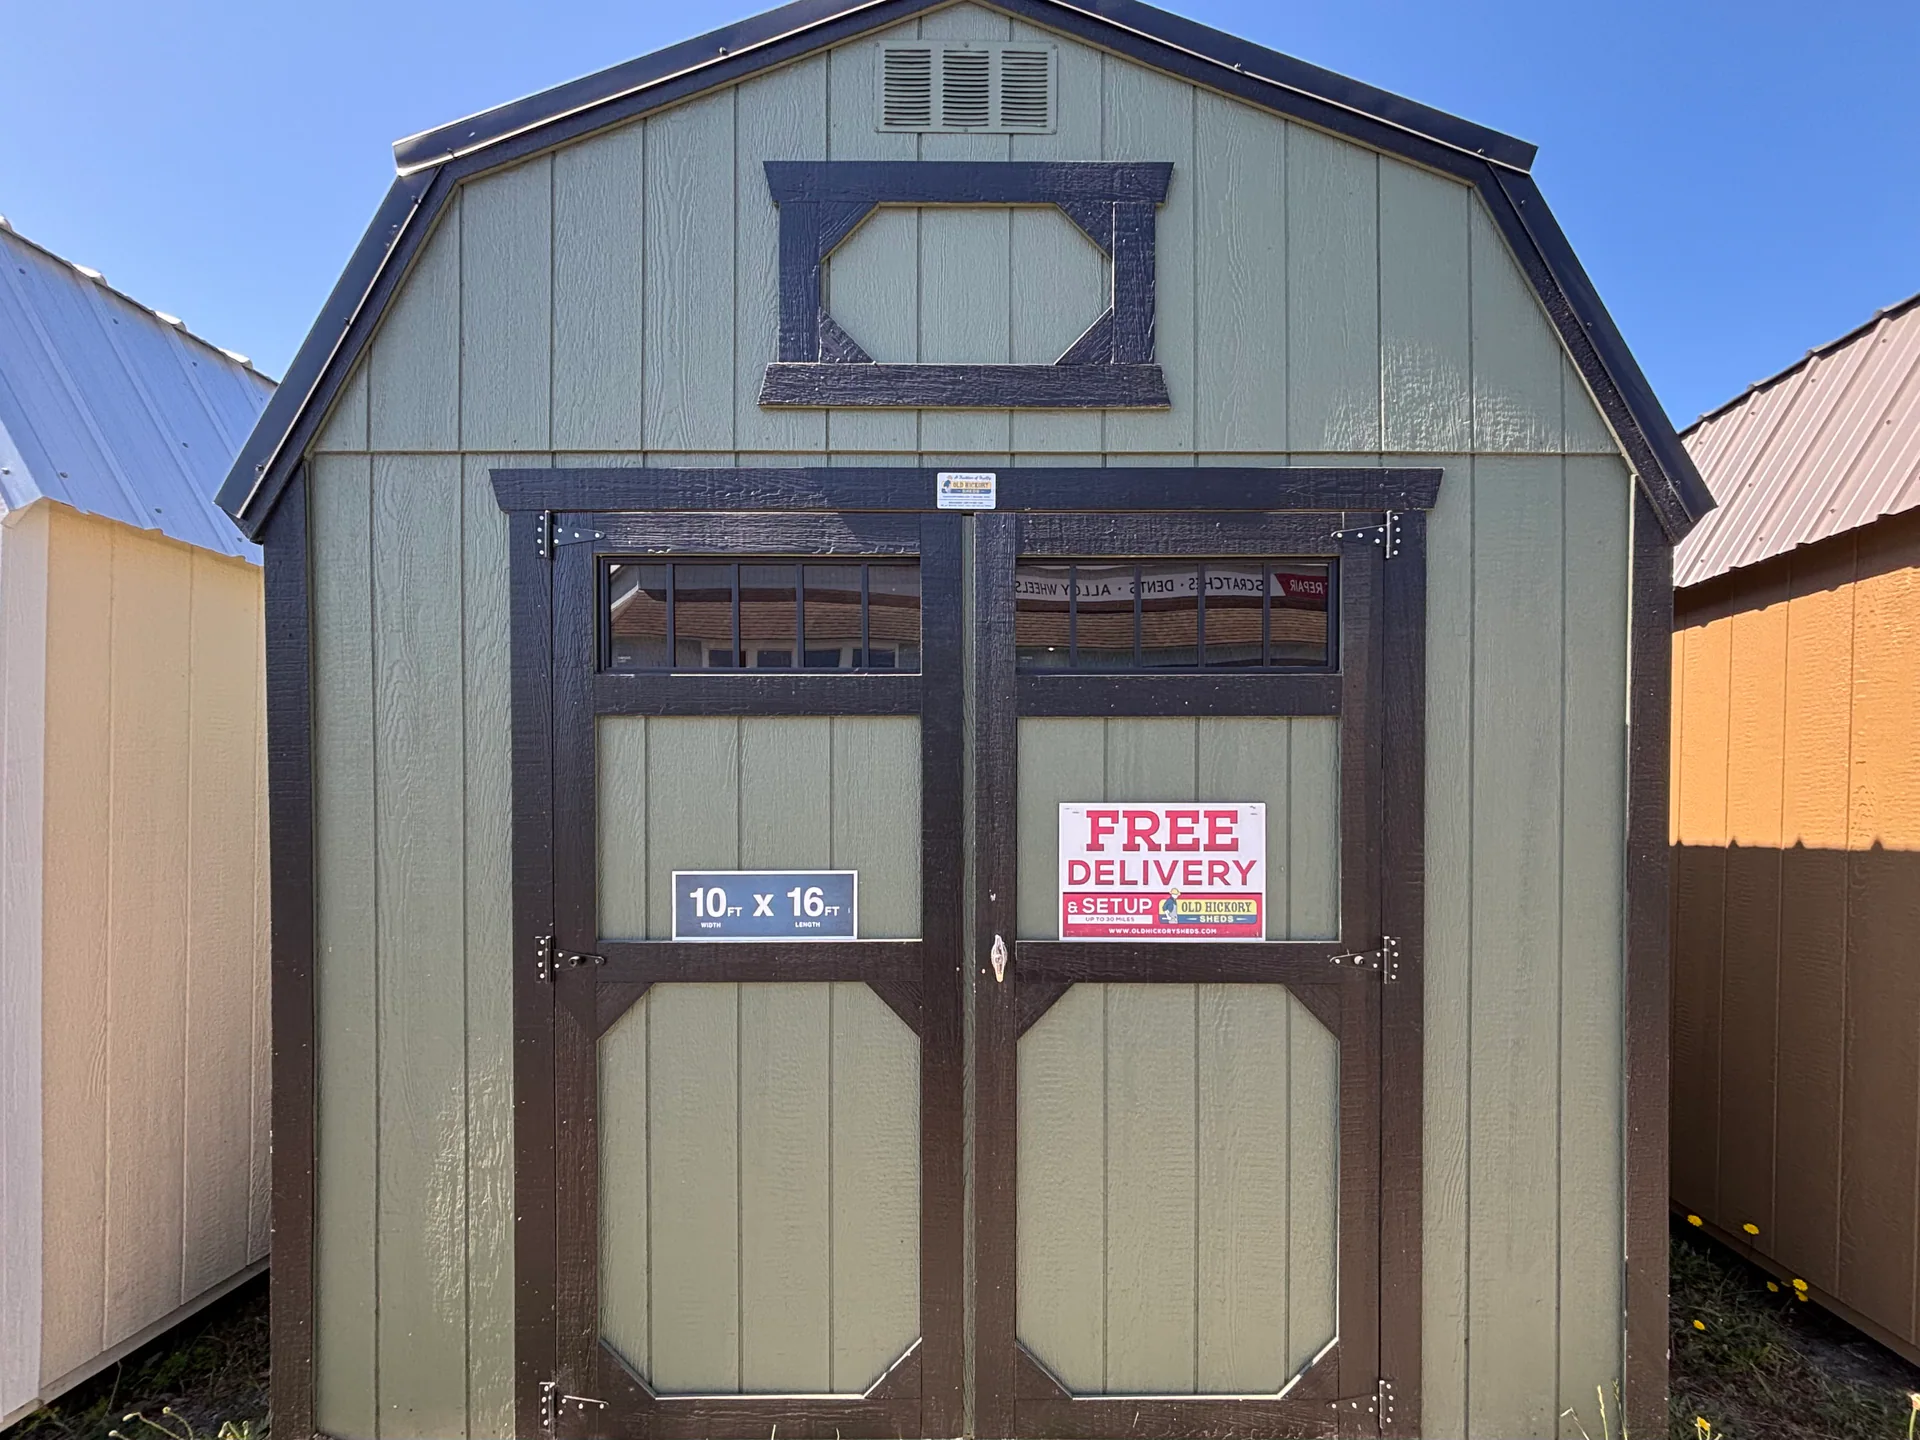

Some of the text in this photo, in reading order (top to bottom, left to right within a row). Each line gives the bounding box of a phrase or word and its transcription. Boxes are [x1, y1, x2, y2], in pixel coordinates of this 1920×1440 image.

[1086, 810, 1239, 852] FREE
[1068, 859, 1257, 886] DELIVERY
[1067, 897, 1153, 914] & SETUP
[1181, 902, 1252, 913] OLD HICKORY
[1199, 915, 1234, 923] SHEDS
